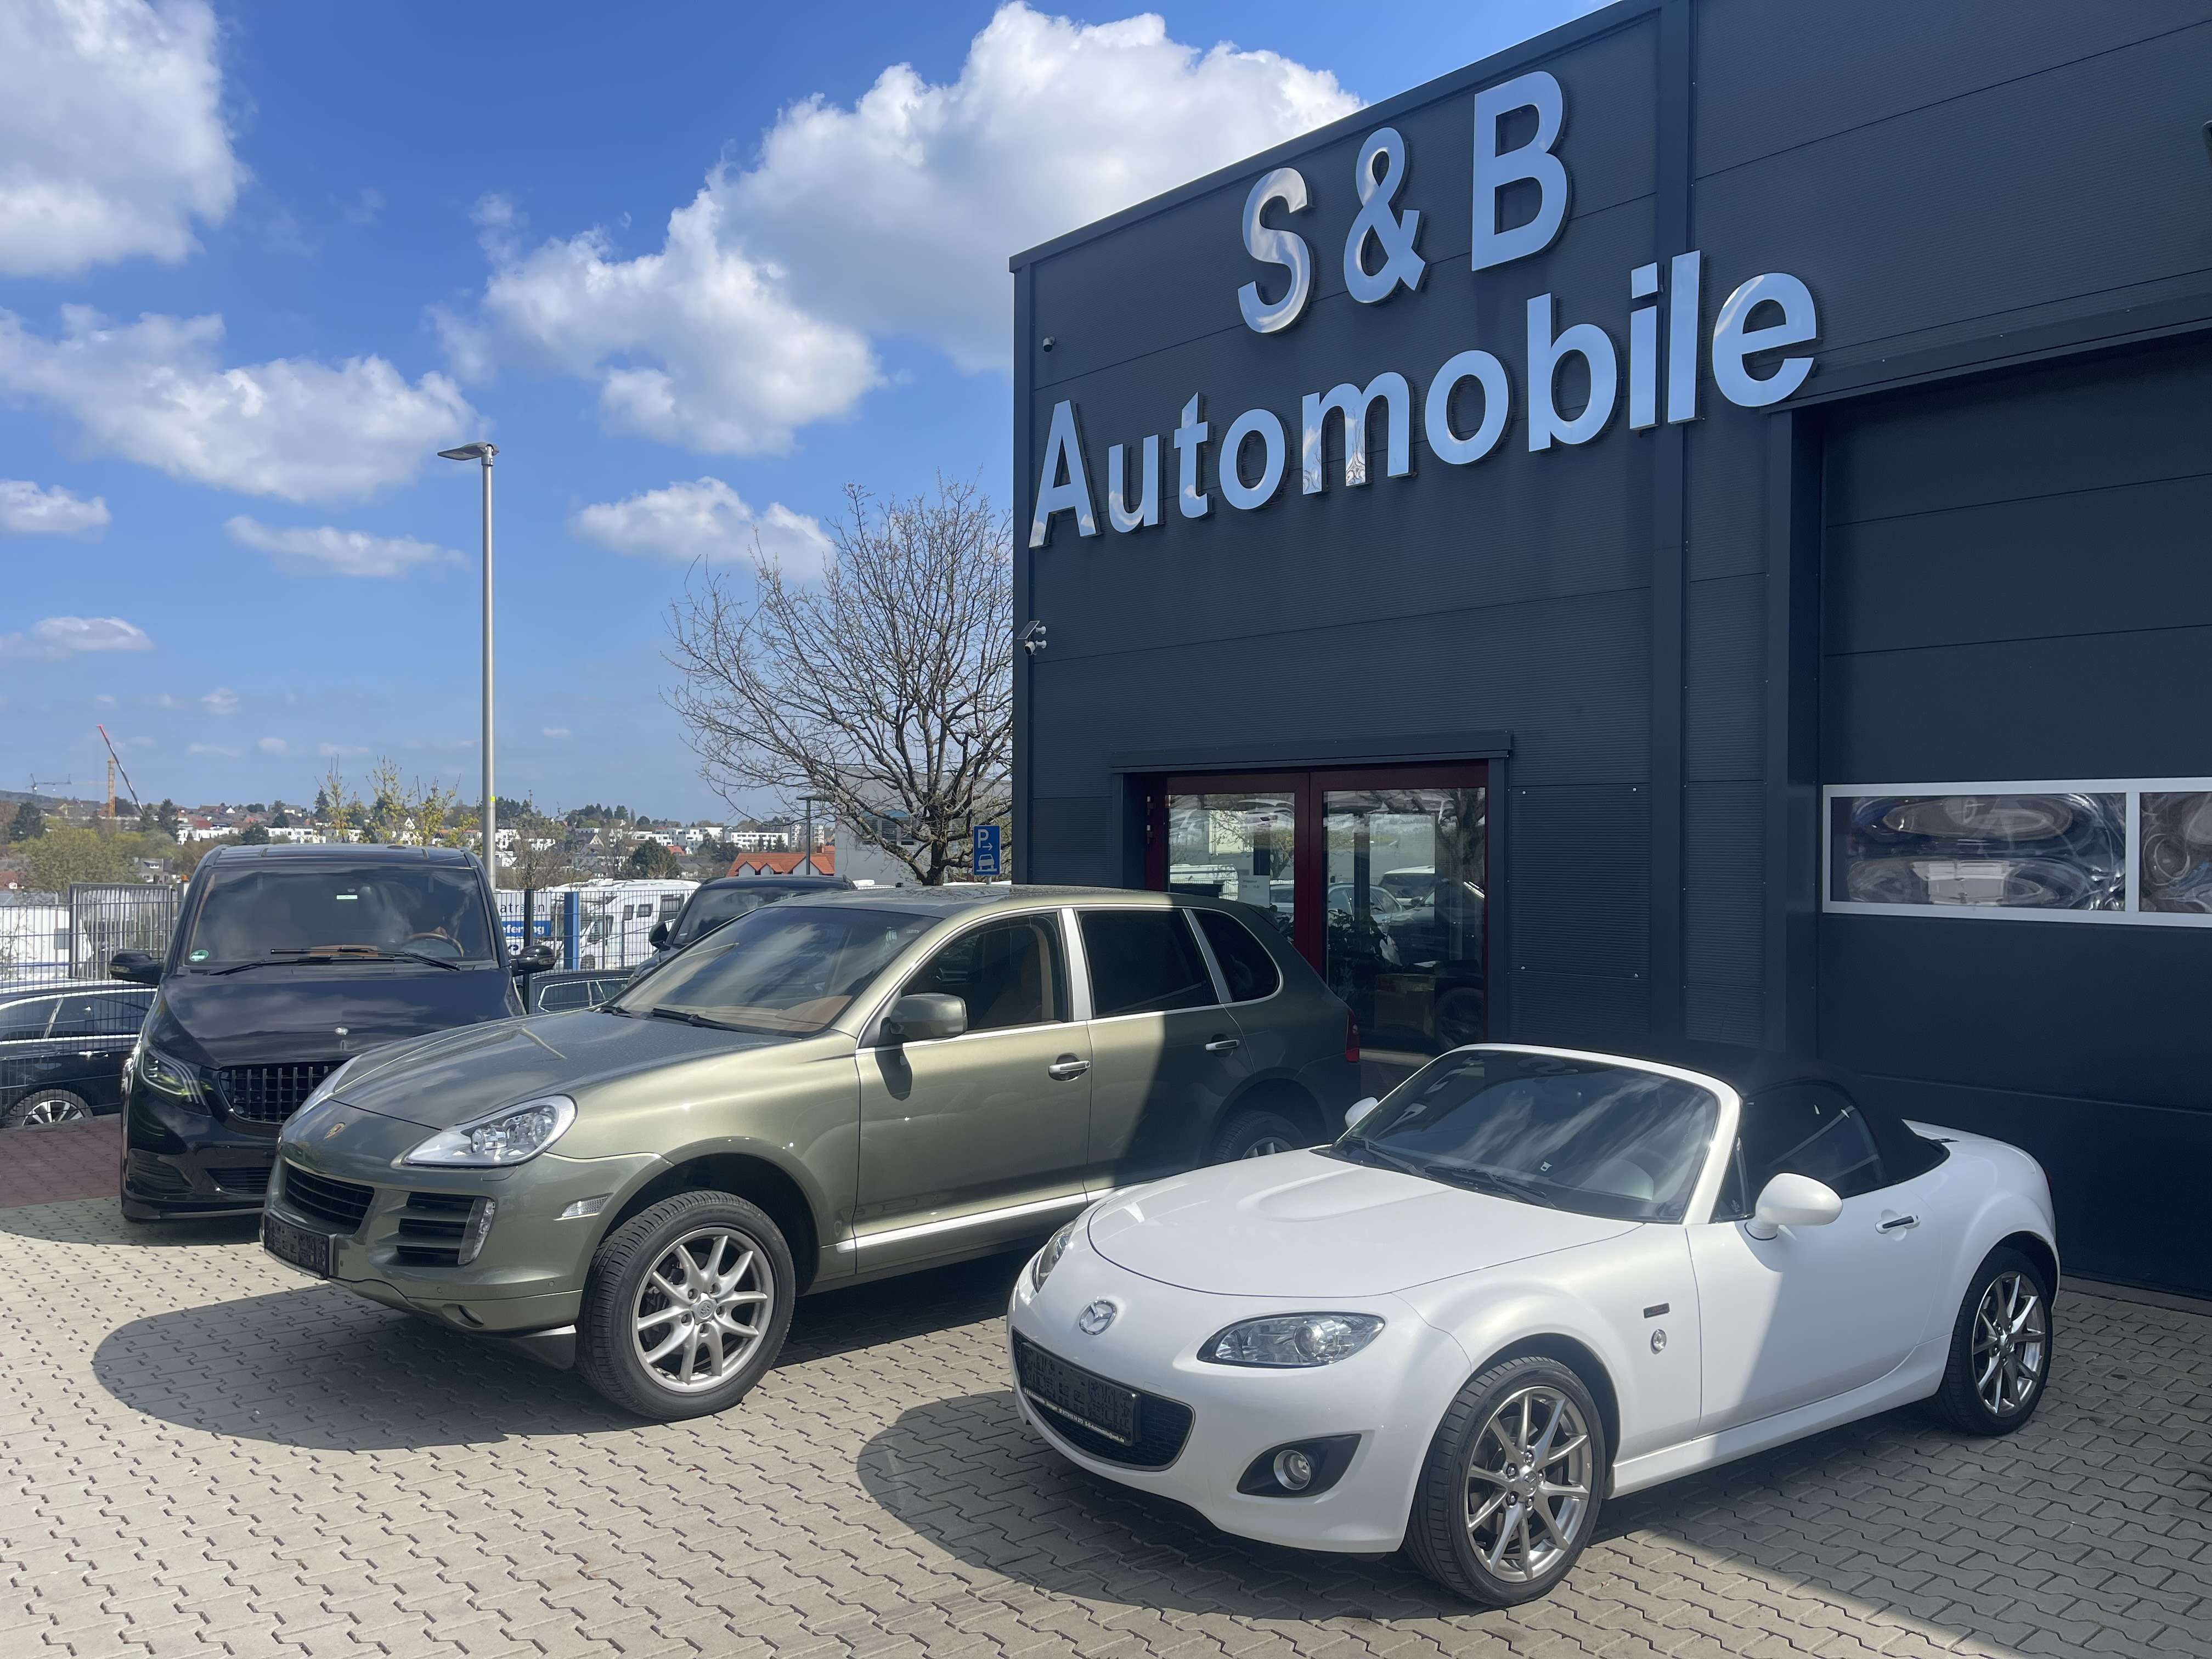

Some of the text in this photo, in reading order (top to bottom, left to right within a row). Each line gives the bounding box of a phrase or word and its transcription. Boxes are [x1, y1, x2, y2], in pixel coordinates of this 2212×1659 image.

[1238, 71, 1569, 333] S & B
[1028, 250, 1818, 548] Automobile
[500, 902, 545, 913] atrn
[978, 829, 989, 848] P
